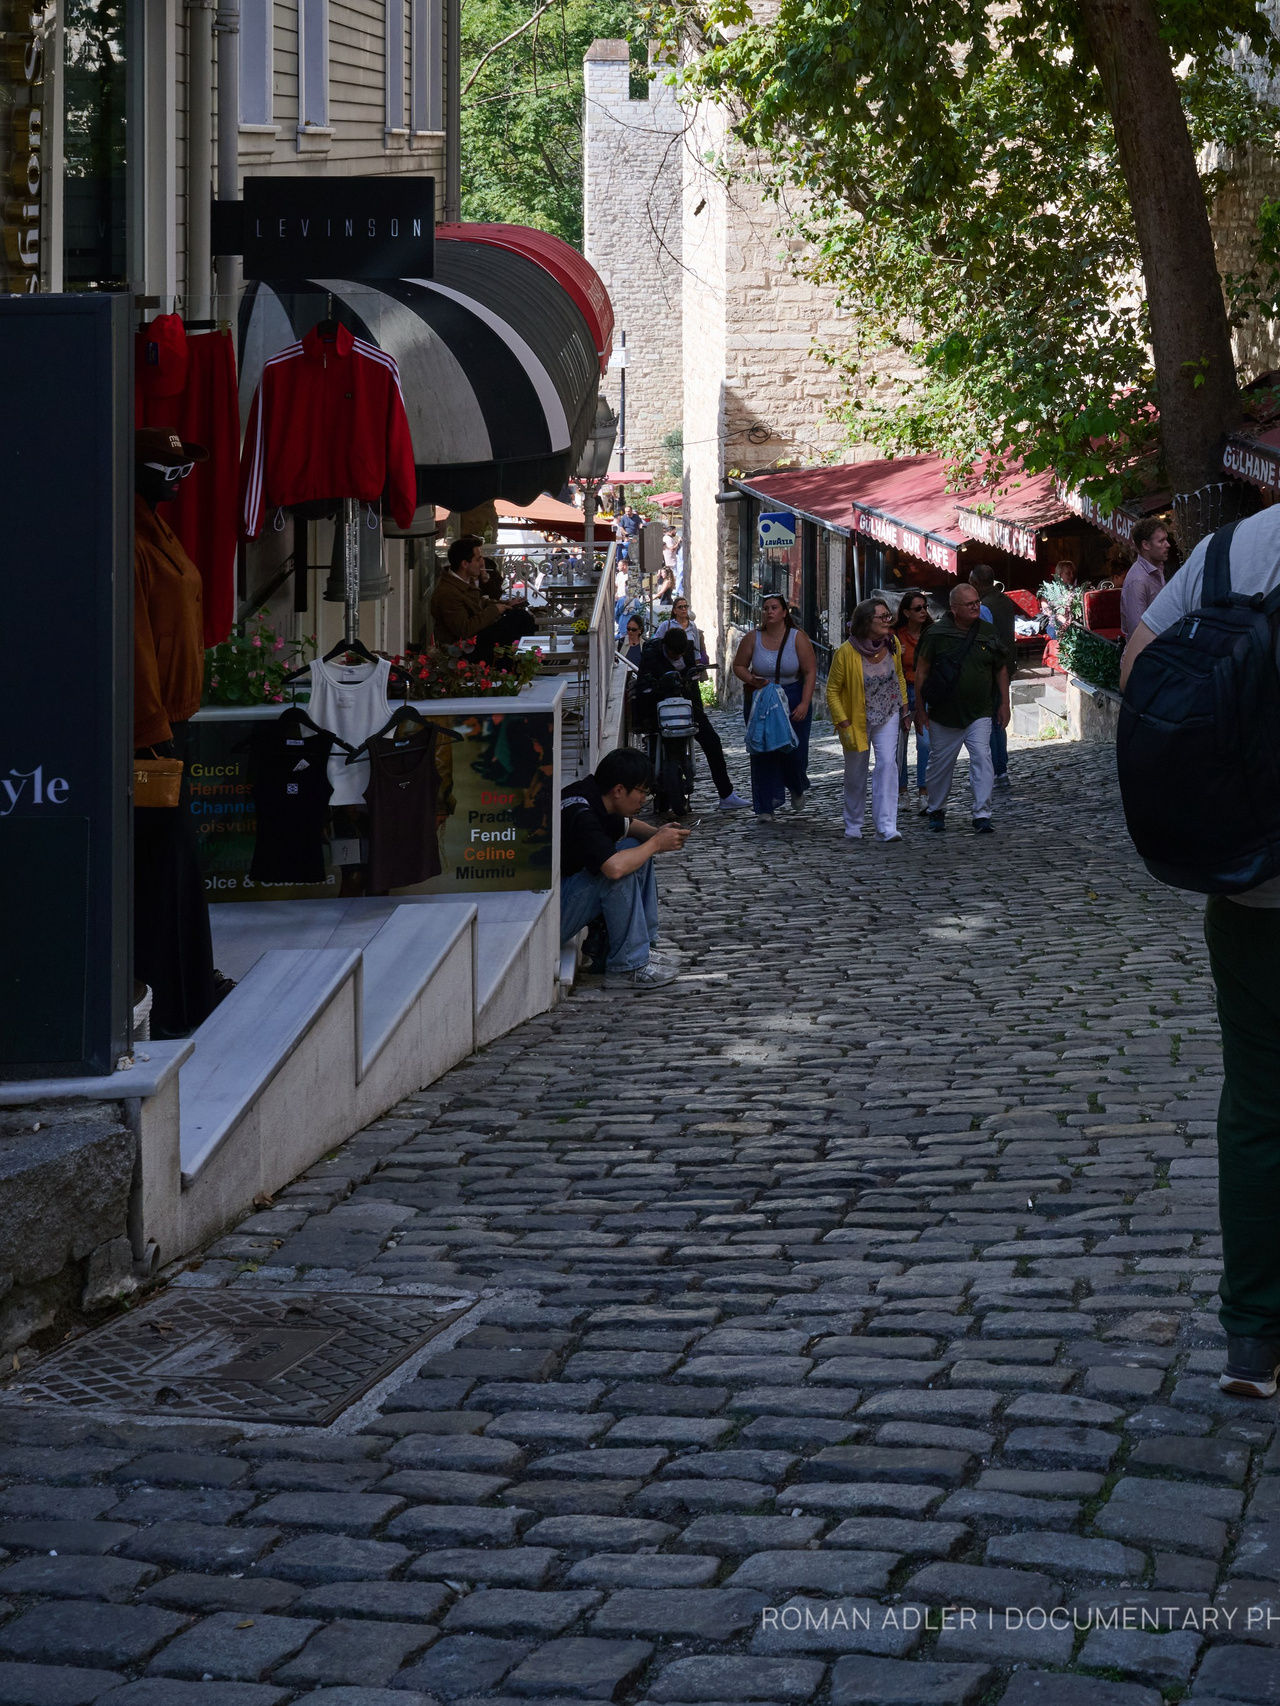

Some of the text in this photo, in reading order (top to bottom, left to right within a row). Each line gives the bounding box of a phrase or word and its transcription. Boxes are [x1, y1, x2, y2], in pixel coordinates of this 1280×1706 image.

[256, 218, 421, 238] LEVINSON
[1223, 445, 1276, 486] GÜLHANE
[1116, 513, 1135, 540] CAF
[764, 536, 793, 546] LAVAZZA
[860, 514, 898, 545] GÜLHANE
[903, 532, 921, 555] SUR
[190, 762, 240, 777] Gucci
[0, 764, 70, 816] yle
[189, 782, 254, 796] Hermes
[481, 790, 516, 805] Dior
[190, 800, 256, 815] Channe
[468, 809, 516, 823] Prada
[470, 827, 516, 842] Fendi
[464, 847, 516, 861] Celine
[456, 865, 516, 880] Miumiu
[205, 875, 237, 890] olce
